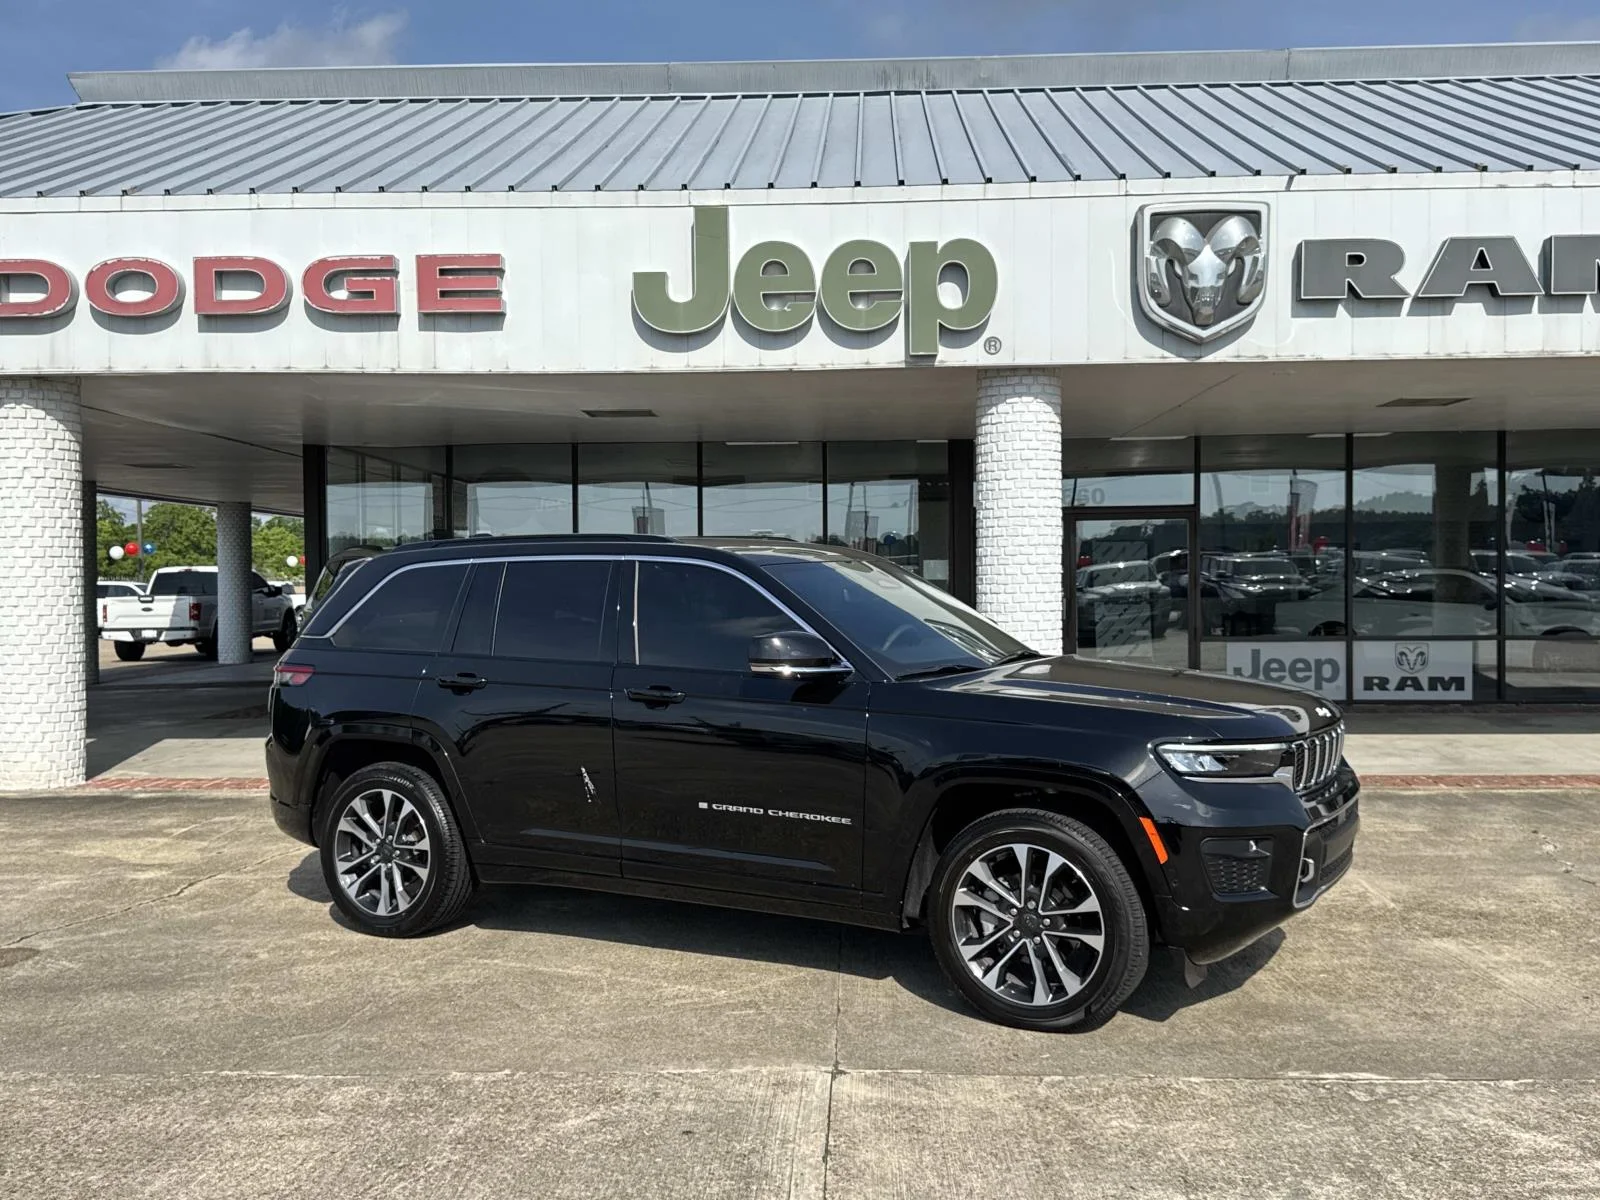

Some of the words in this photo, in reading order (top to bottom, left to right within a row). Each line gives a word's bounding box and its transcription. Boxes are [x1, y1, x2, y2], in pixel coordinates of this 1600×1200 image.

[0, 253, 506, 318] DODGE
[632, 205, 998, 356] Jeep
[1233, 649, 1340, 691] Jeep
[1363, 676, 1465, 691] RAM
[712, 803, 764, 815] GRAND
[767, 809, 852, 825] CHEROKEE
